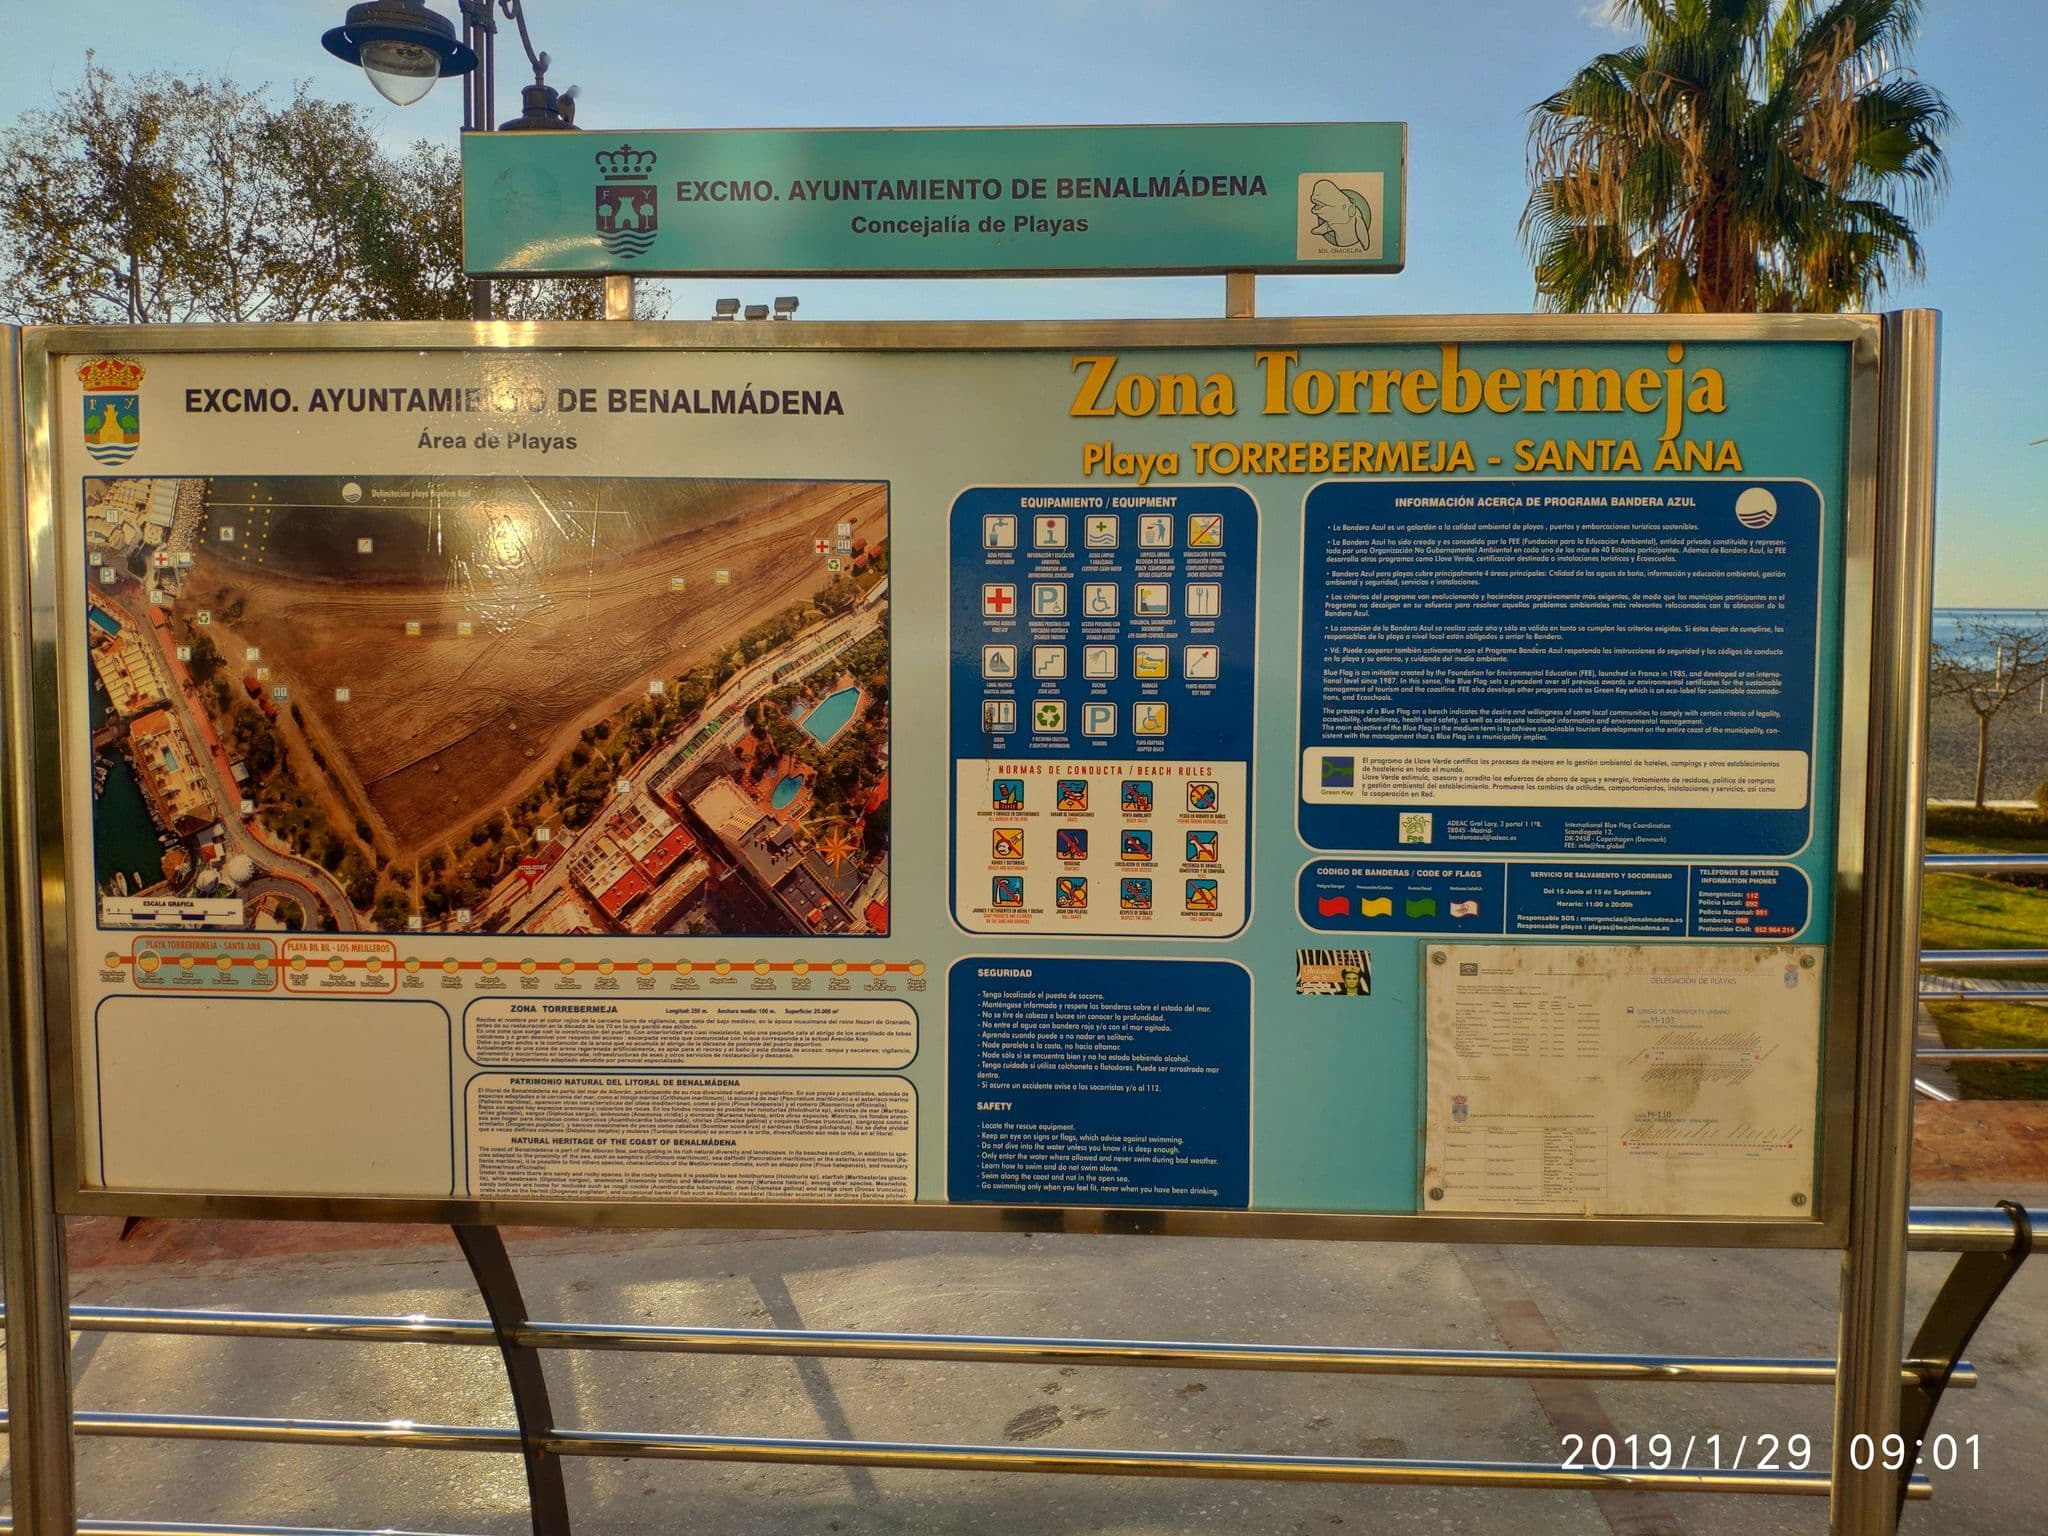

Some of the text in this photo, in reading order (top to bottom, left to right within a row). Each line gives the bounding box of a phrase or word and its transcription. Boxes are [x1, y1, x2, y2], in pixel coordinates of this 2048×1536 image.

[677, 171, 1268, 202] EXCMO. AYUNTAMIENTO DE BENALMÁDENA
[852, 215, 1088, 238] Concejalía de Playas
[1070, 342, 1728, 442] Zona Torrebermeja
[185, 382, 844, 416] EXCMO. AYUNTAMIEO DE BENALMÁDENA
[418, 427, 578, 454] Área de Playas
[1083, 442, 1179, 486] Playa
[1191, 441, 1475, 474] TORREBERMEJA
[1514, 440, 1643, 472] SANTA
[1655, 440, 1743, 472] ANA
[1020, 497, 1104, 508] EQUIPAMIENTO
[1112, 497, 1178, 508] EQUIPMENT
[1394, 497, 1696, 507] INFORMACIÓN ACERCA DE PROGRAMA BANDERA AZUL
[998, 765, 1042, 774] NORMAS
[1048, 766, 1061, 774] DE
[1066, 766, 1123, 775] CONDUCTA
[1137, 766, 1172, 775] BEACH
[1178, 767, 1212, 776] RULES
[146, 940, 165, 949] PLAYA
[287, 943, 307, 951] PLAYA
[321, 944, 330, 952] BIL
[336, 944, 349, 952] LOS
[351, 944, 390, 952] MELILLEROS
[977, 969, 1032, 977] SEGURIDAD
[976, 1102, 1012, 1110] SAFETY
